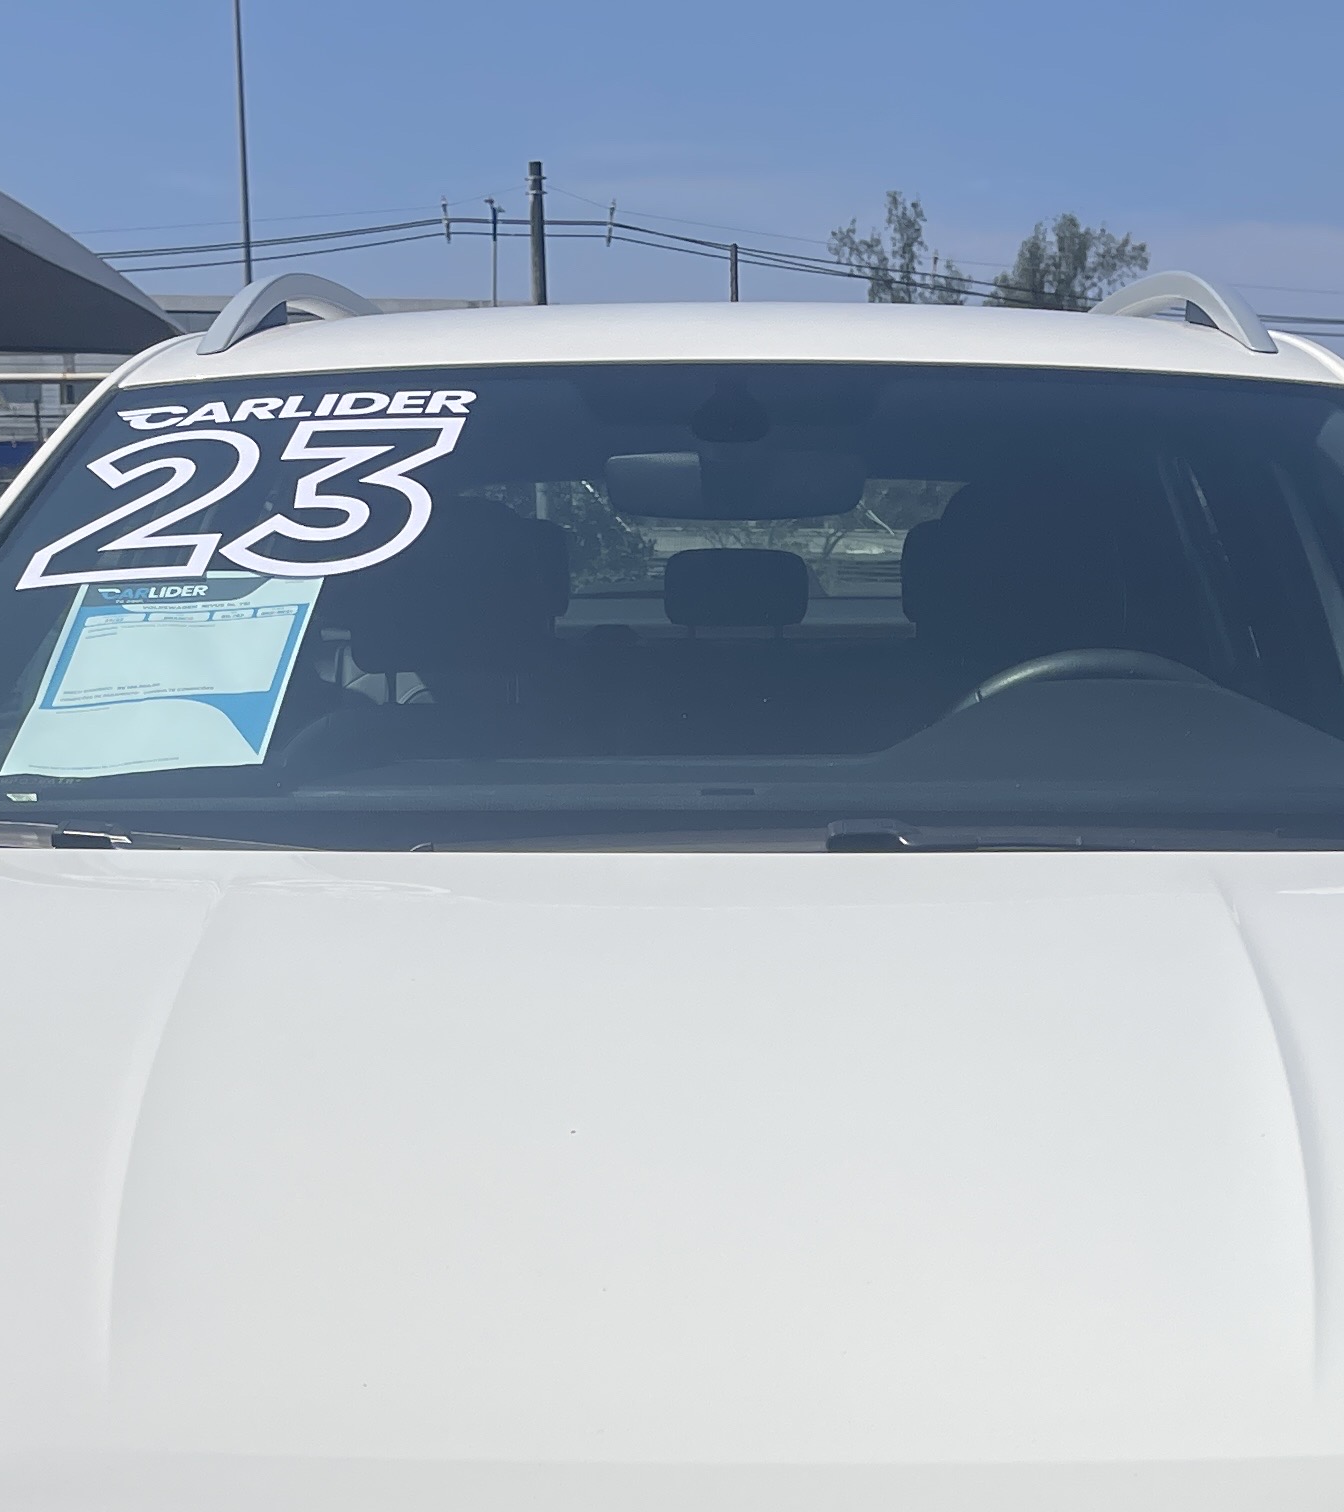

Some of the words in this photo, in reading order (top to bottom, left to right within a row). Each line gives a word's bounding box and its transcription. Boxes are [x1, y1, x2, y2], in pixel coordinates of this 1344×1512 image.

[117, 390, 477, 431] CARLIDER
[15, 416, 467, 591] 23
[97, 584, 209, 600] CARLIDER
